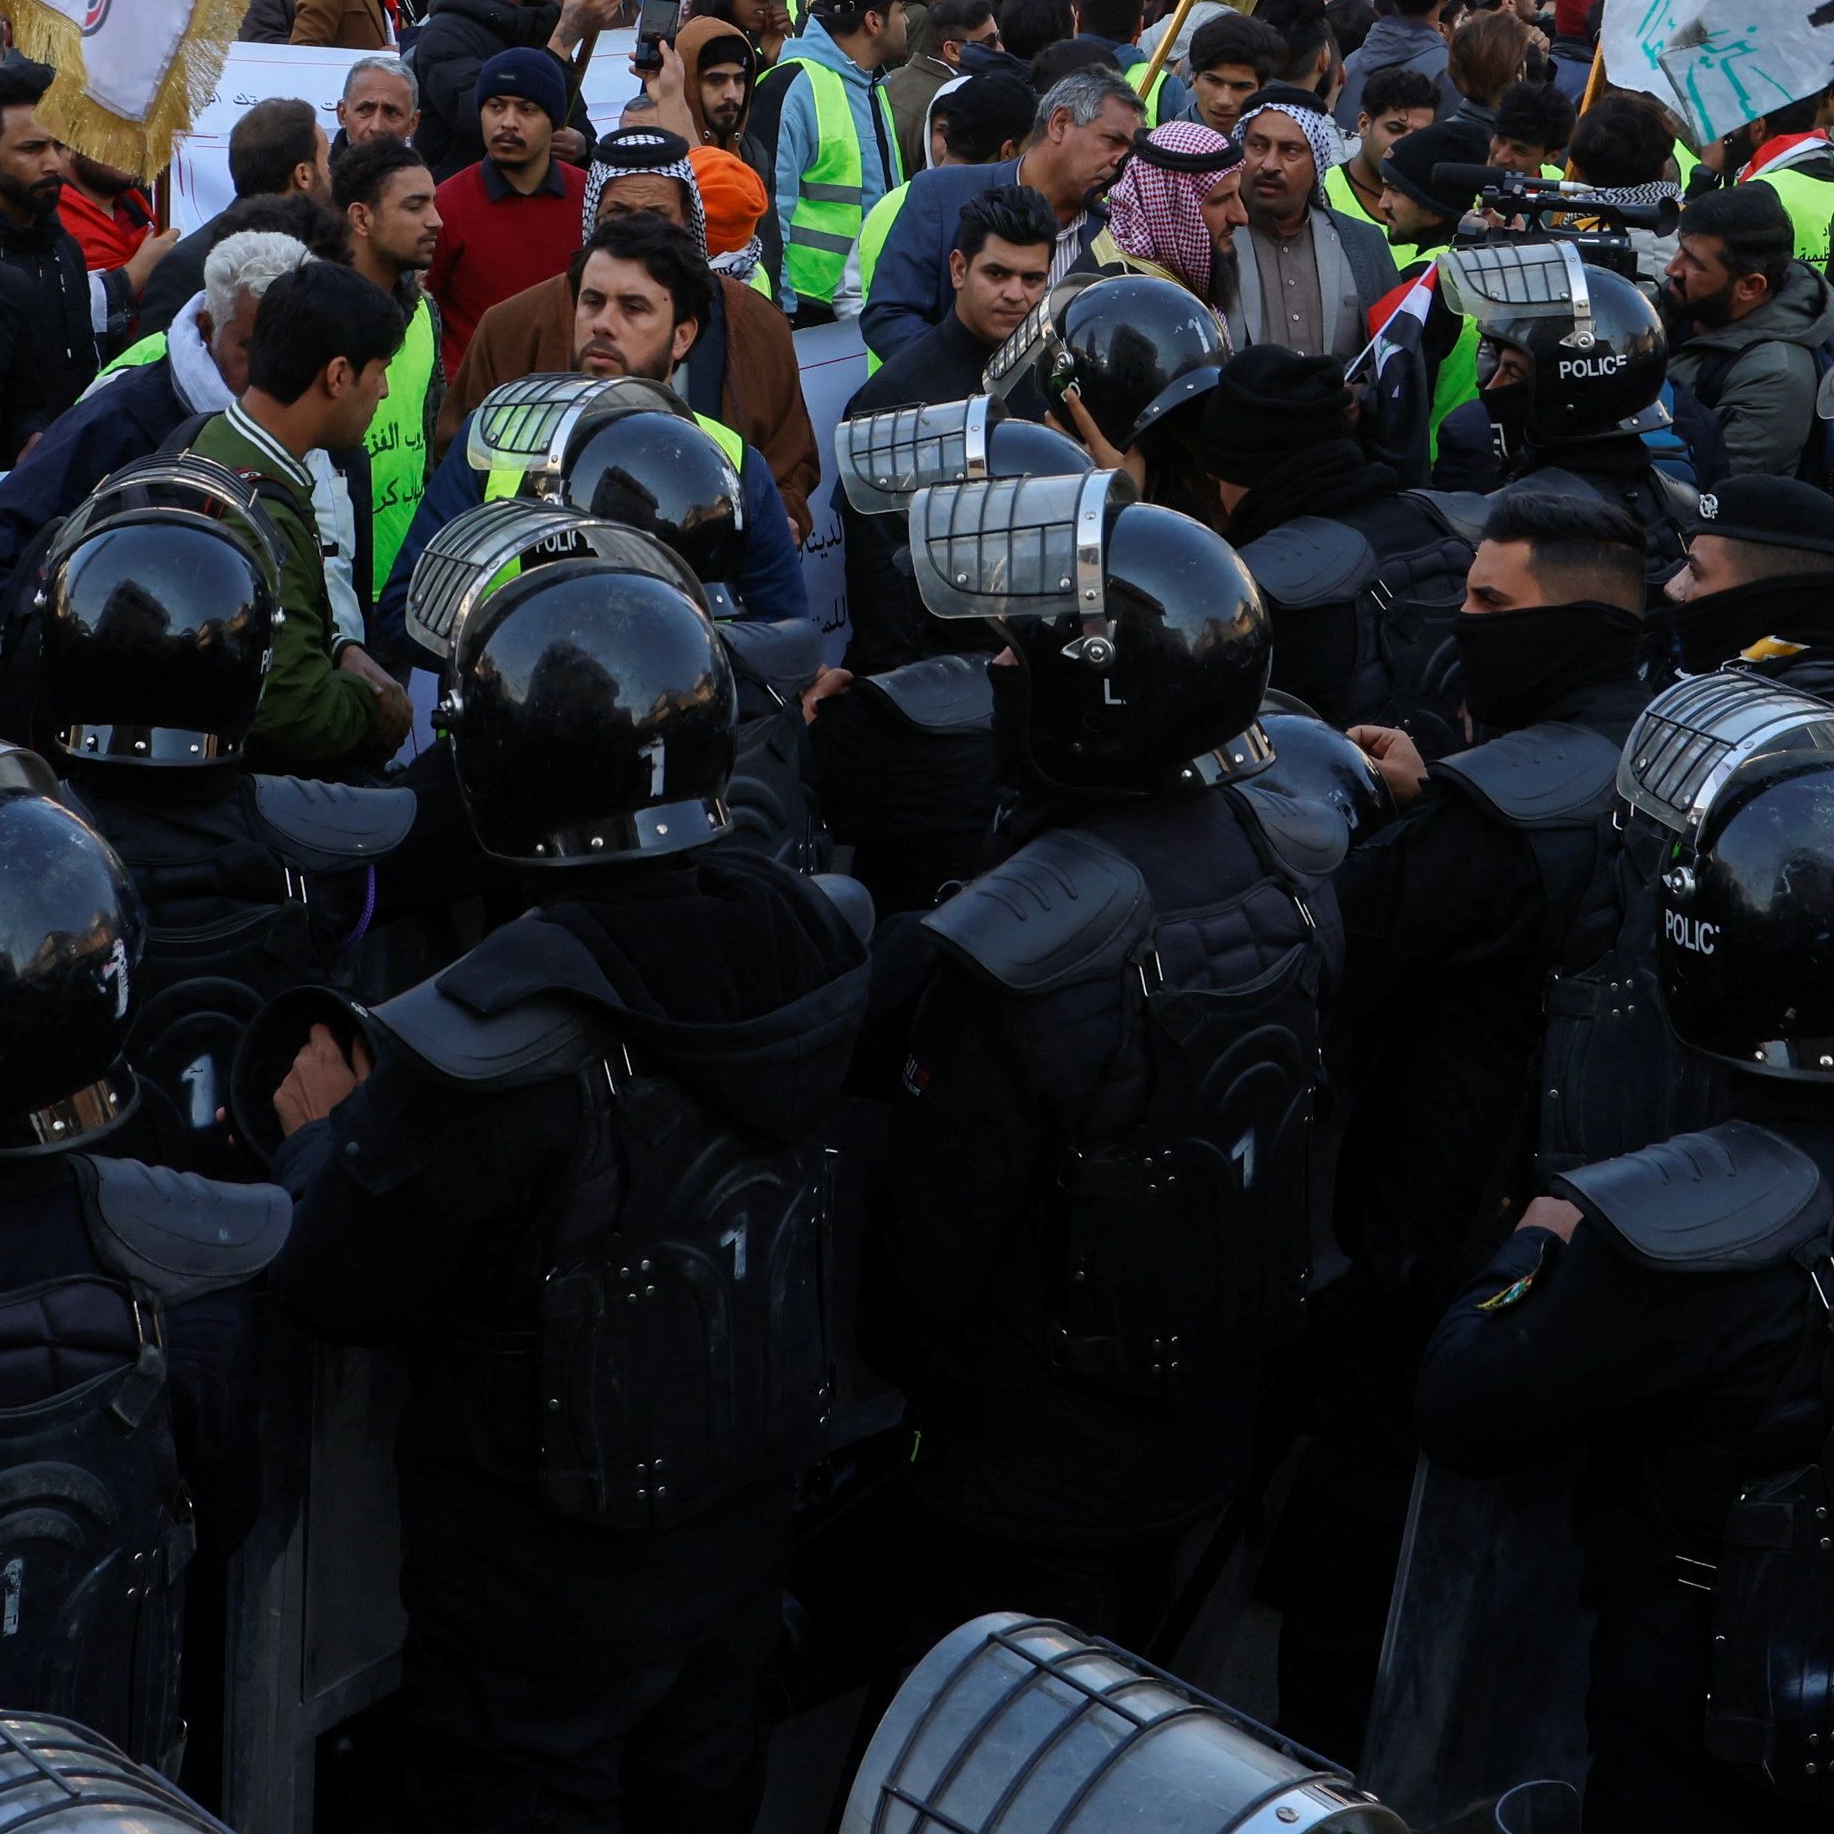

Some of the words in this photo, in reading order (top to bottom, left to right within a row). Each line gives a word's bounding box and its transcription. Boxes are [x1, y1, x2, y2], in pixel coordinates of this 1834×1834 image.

[1558, 353, 1628, 379] POLICE
[180, 1053, 219, 1131] 1
[1231, 1128, 1258, 1190] 1
